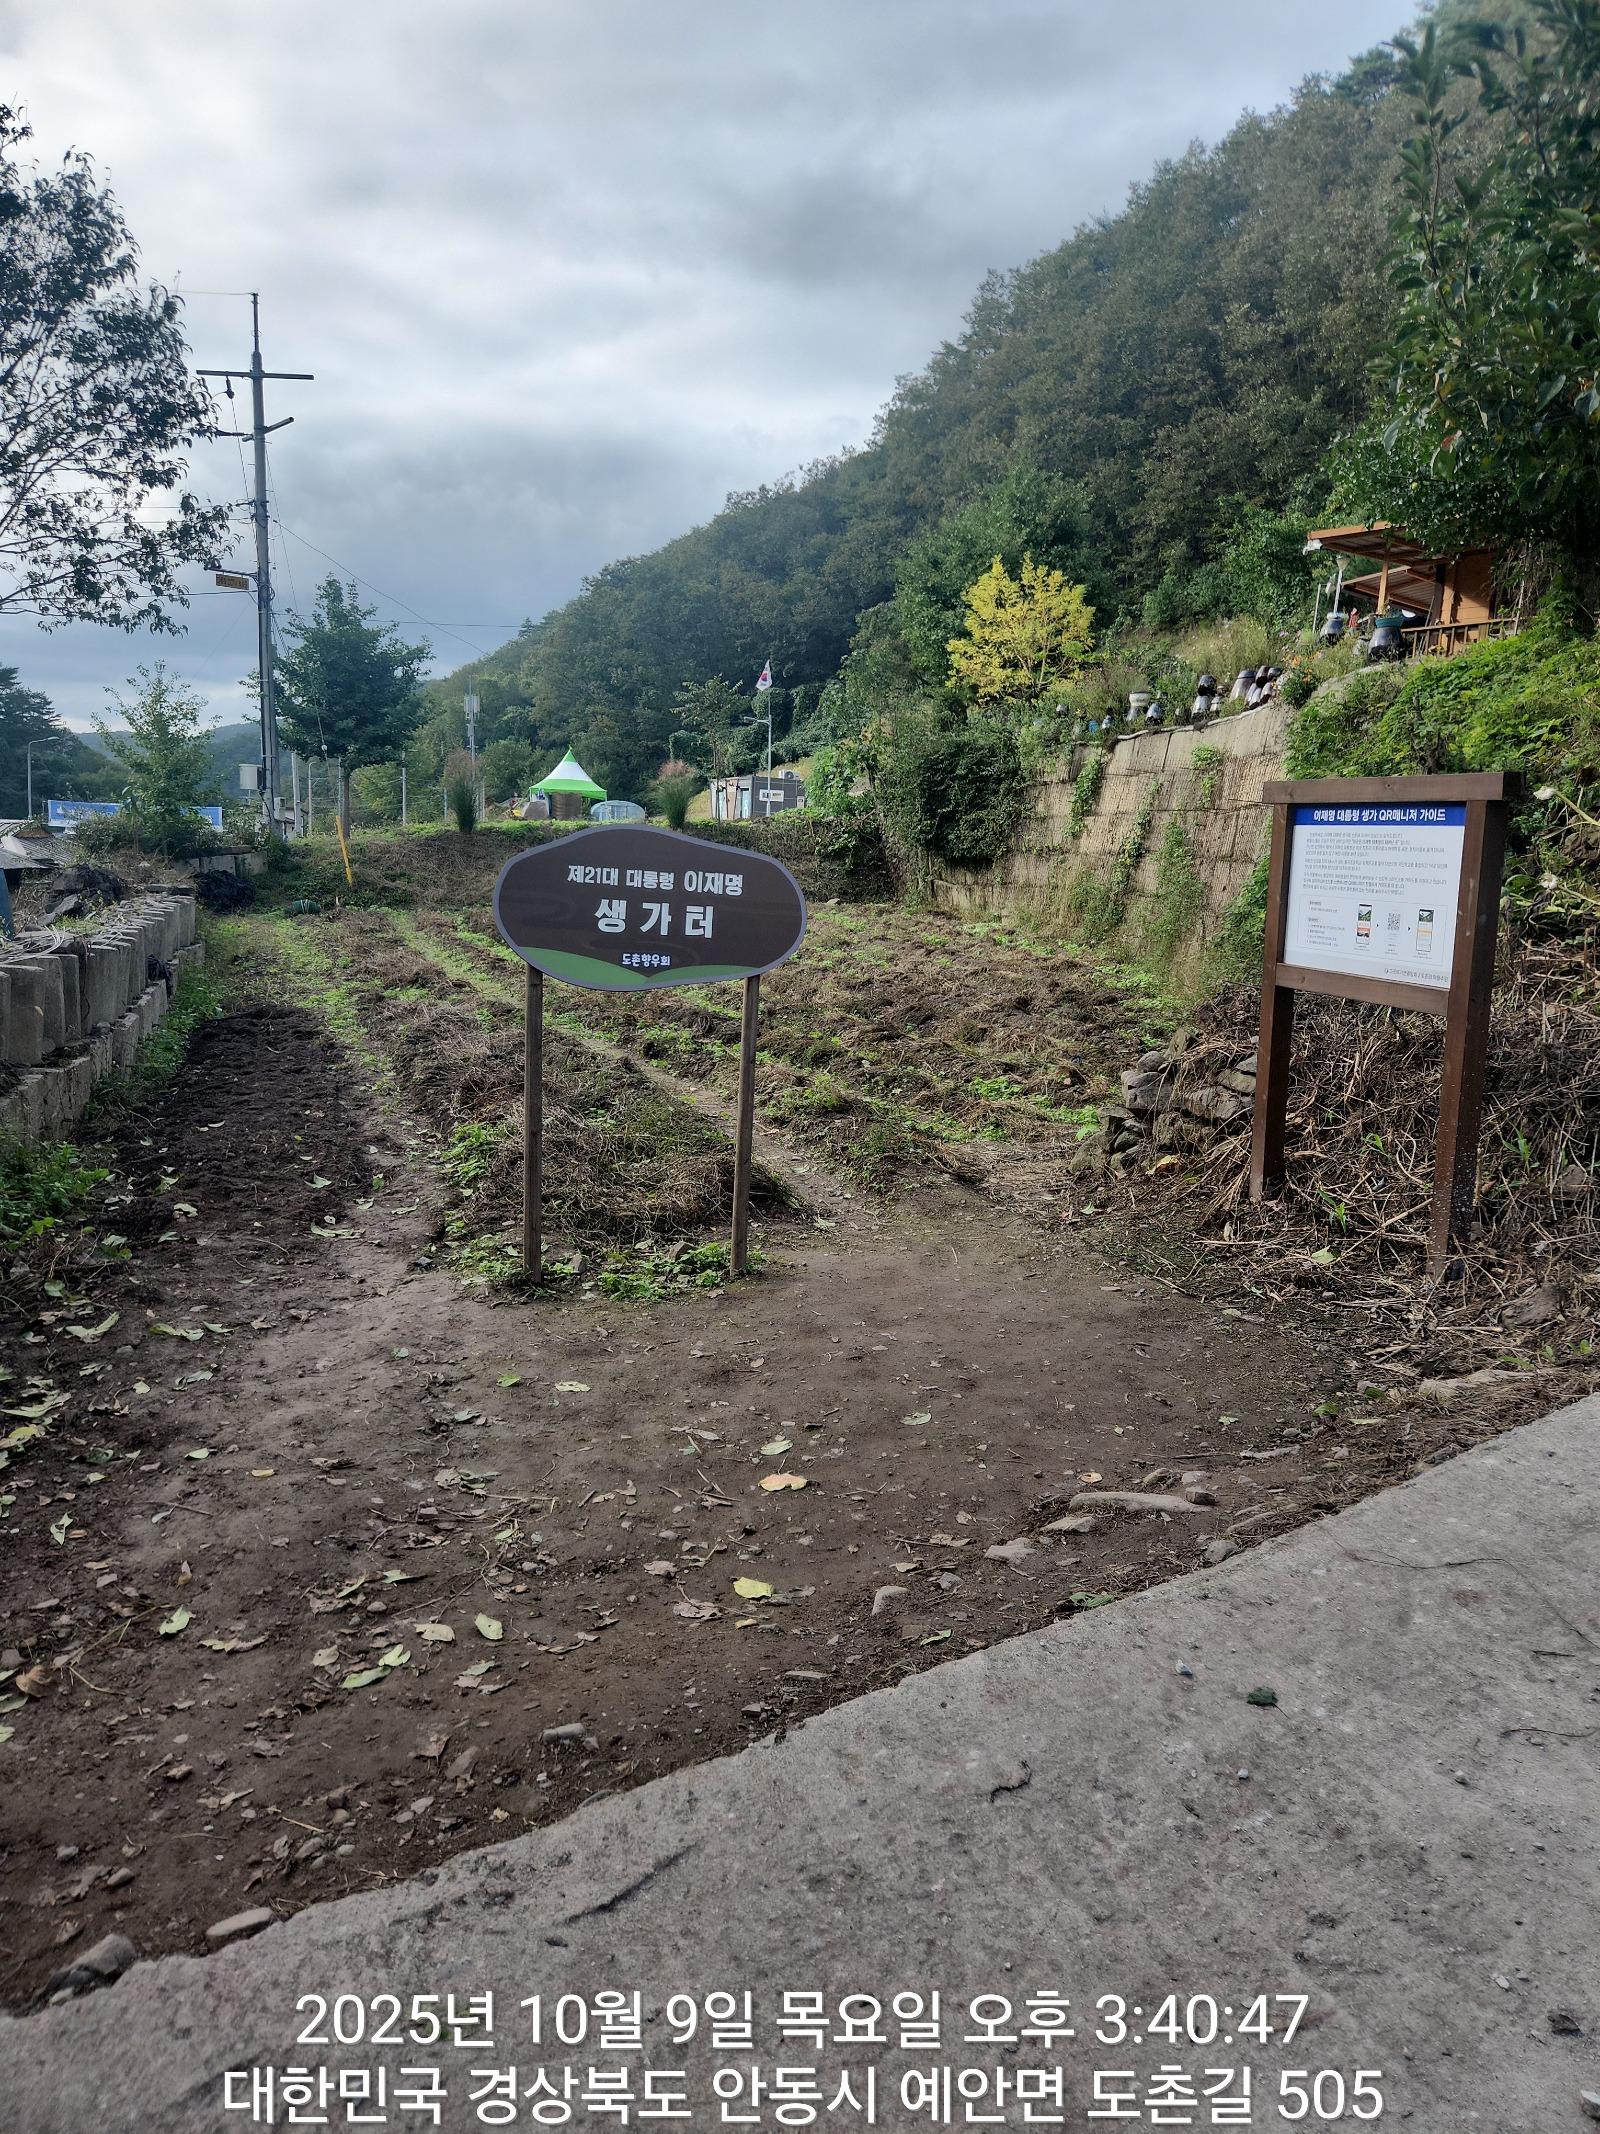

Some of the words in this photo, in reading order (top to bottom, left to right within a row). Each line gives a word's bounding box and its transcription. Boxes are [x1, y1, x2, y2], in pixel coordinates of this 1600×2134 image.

[1314, 809, 1335, 821] 이재명
[1337, 809, 1359, 821] 대통령
[1361, 809, 1377, 821] 생가
[1379, 809, 1417, 821] QR매니저
[1420, 809, 1445, 821] 가이드
[567, 864, 619, 886] 제21대
[626, 869, 675, 891] 대통령
[683, 870, 744, 896] 이재명
[622, 953, 671, 967] 도촌향우회
